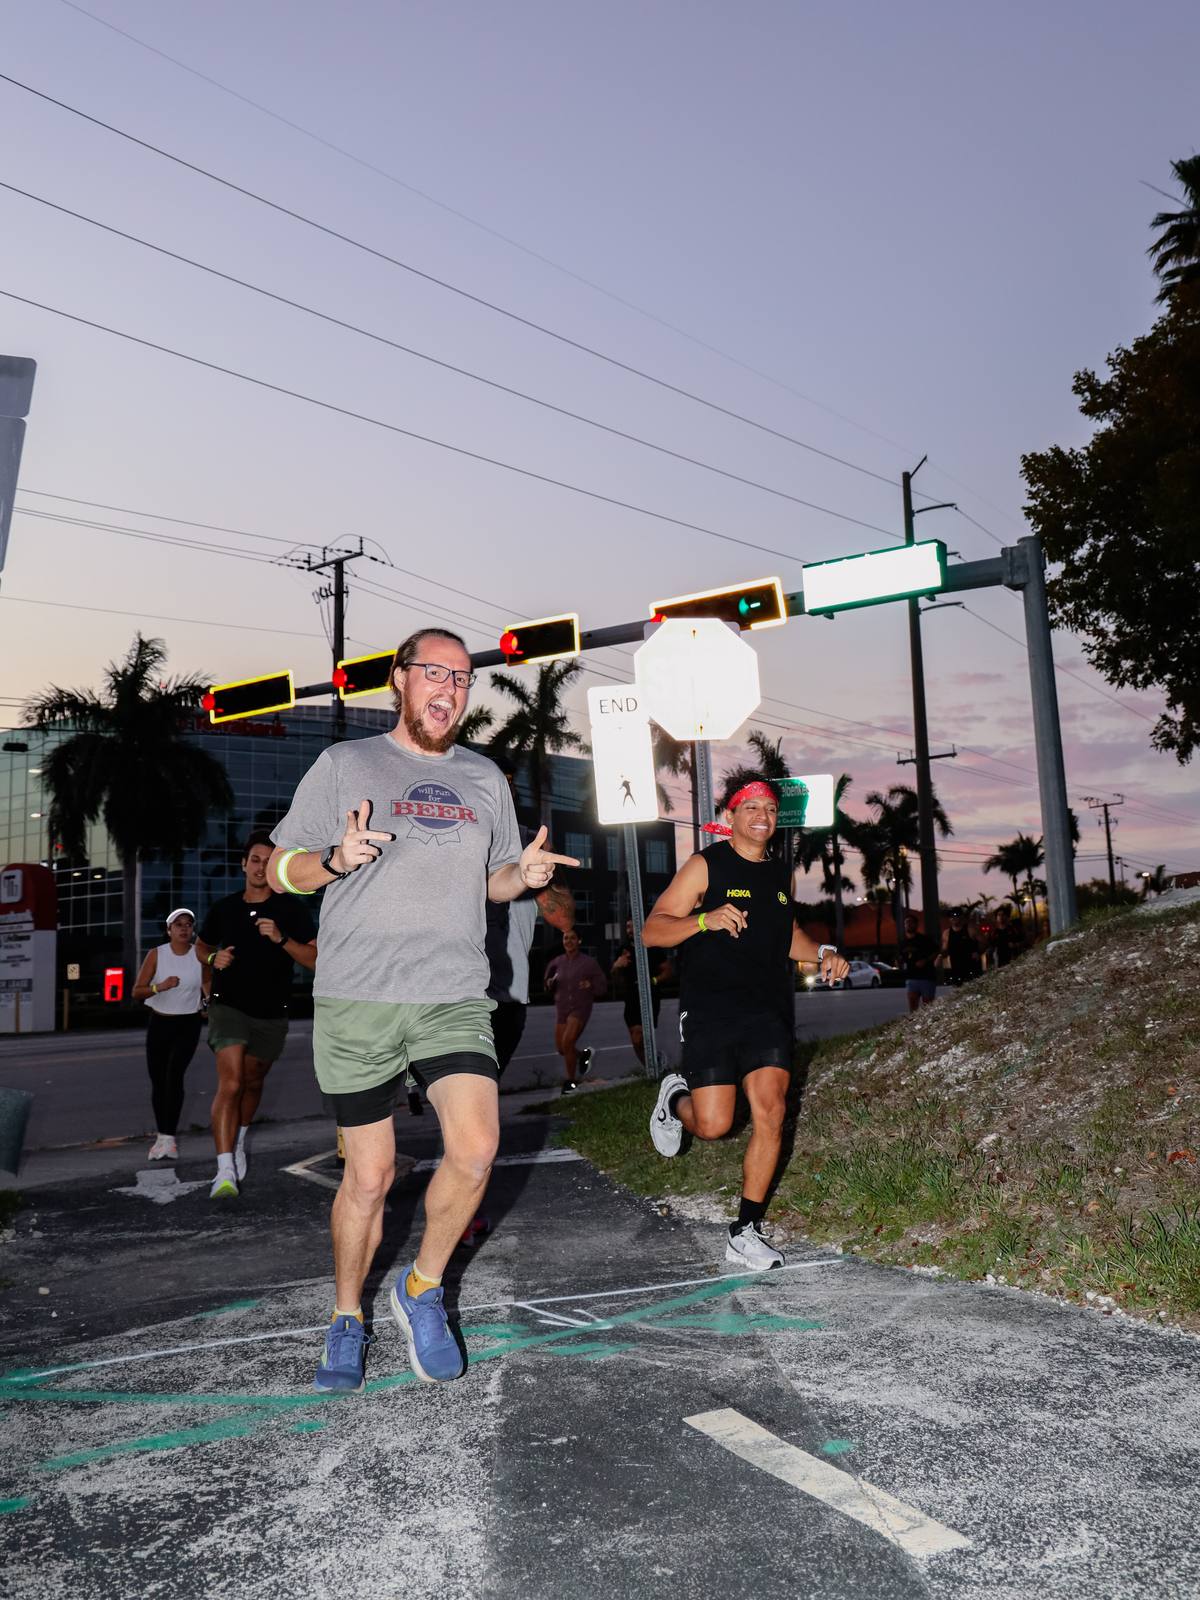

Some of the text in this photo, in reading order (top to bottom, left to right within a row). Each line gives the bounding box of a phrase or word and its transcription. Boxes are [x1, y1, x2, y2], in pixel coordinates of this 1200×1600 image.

[600, 697, 638, 713] END
[418, 787, 434, 795] will
[392, 801, 479, 823] BEER
[726, 889, 751, 898] HOKA
